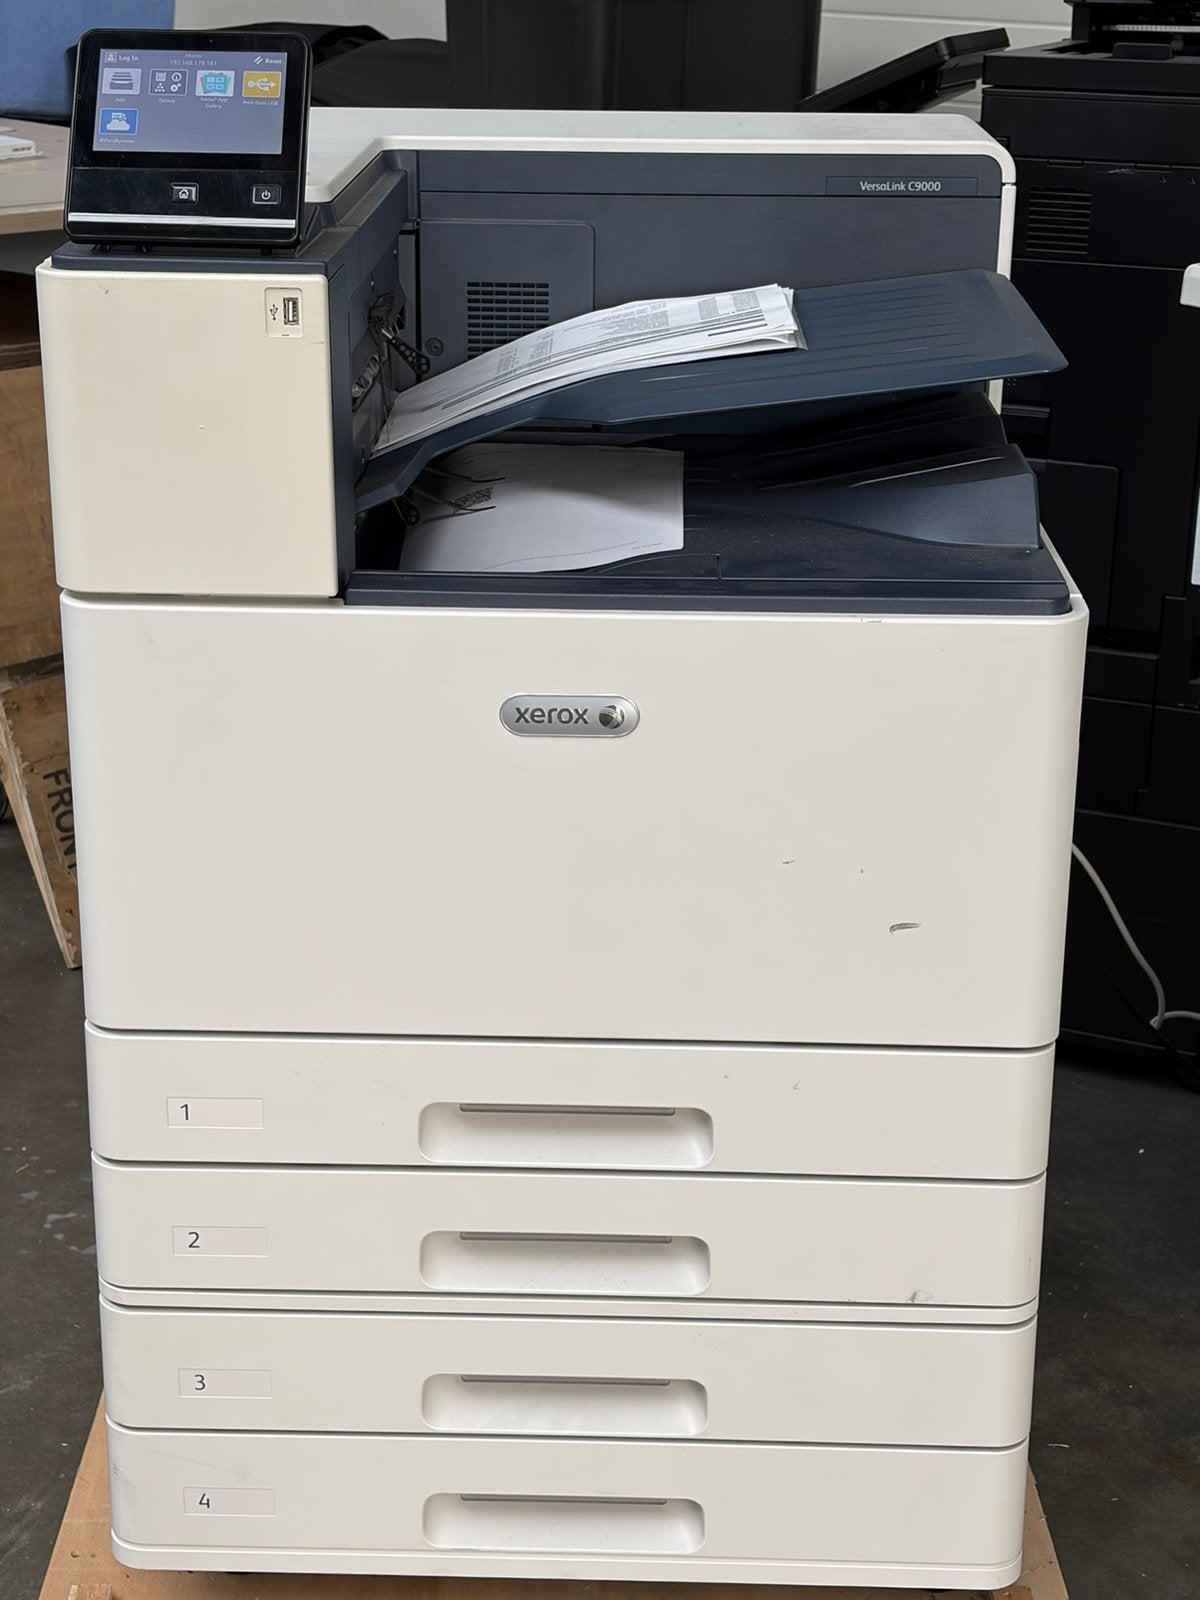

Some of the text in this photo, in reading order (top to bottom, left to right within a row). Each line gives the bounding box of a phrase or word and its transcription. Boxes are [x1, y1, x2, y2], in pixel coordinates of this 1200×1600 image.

[859, 181, 941, 192] VersaLink C9000
[514, 706, 590, 725] xerox
[180, 1104, 191, 1121] 1
[187, 1231, 201, 1249] 2
[193, 1374, 207, 1392] 3
[198, 1493, 211, 1509] 4
